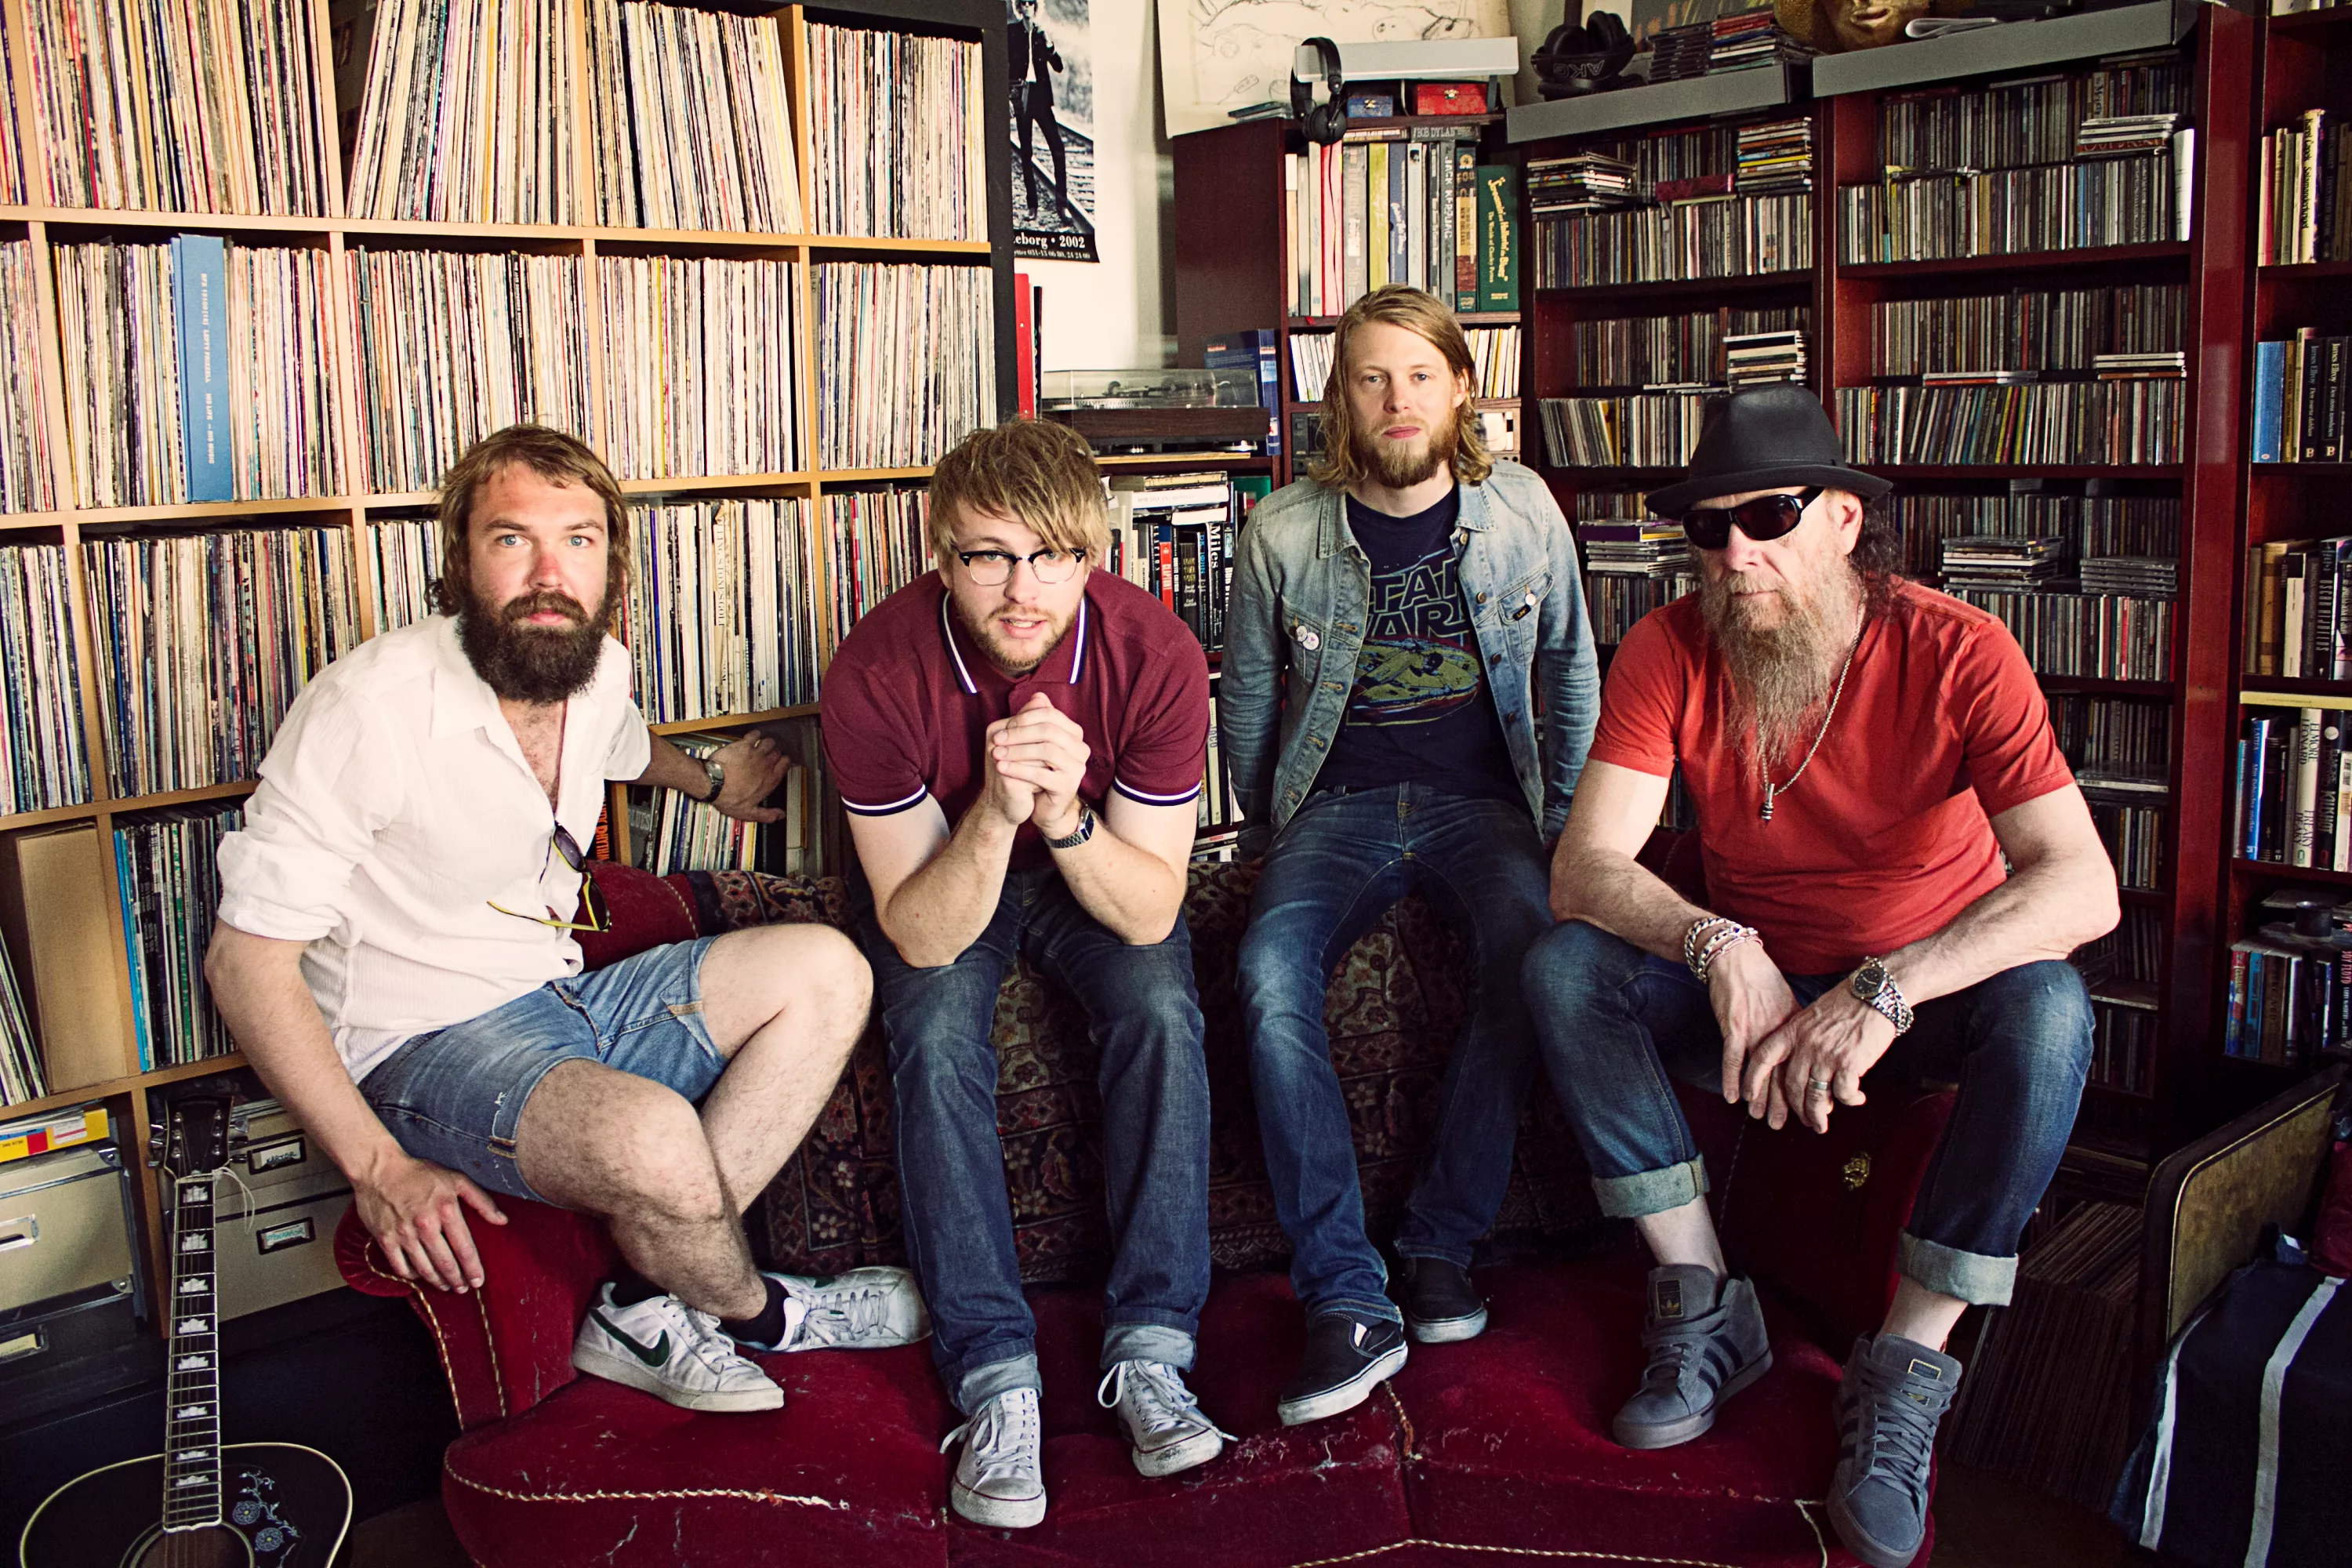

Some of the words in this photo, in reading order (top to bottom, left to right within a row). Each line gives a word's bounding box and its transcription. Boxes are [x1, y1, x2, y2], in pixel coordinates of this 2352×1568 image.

[1552, 60, 1605, 78] AKG
[1417, 126, 1429, 138] BOB
[1431, 126, 1455, 137] DYLAN
[2305, 118, 2314, 139] Karel
[1444, 156, 1454, 185] JACK
[1444, 190, 1454, 239] KEROUAC
[1014, 232, 1048, 249] eborg
[1059, 235, 1085, 249] 2002
[2310, 345, 2319, 365] James
[2331, 343, 2340, 362] James
[2309, 365, 2318, 385] Ellroy
[2328, 363, 2339, 383] Ellroy
[1210, 525, 1221, 569] Miles
[2318, 579, 2333, 606] OSCAR
[2315, 609, 2332, 652] HIJUELOS
[2298, 718, 2310, 765] LEONARD
[2308, 723, 2321, 762] ELMORE
[2330, 750, 2340, 783] ELMORE
[2320, 790, 2336, 834] KILLSHOT
[2293, 812, 2304, 845] DEAKY
[2303, 810, 2314, 849] FREAKY
[2340, 964, 2351, 985] FLOYD
